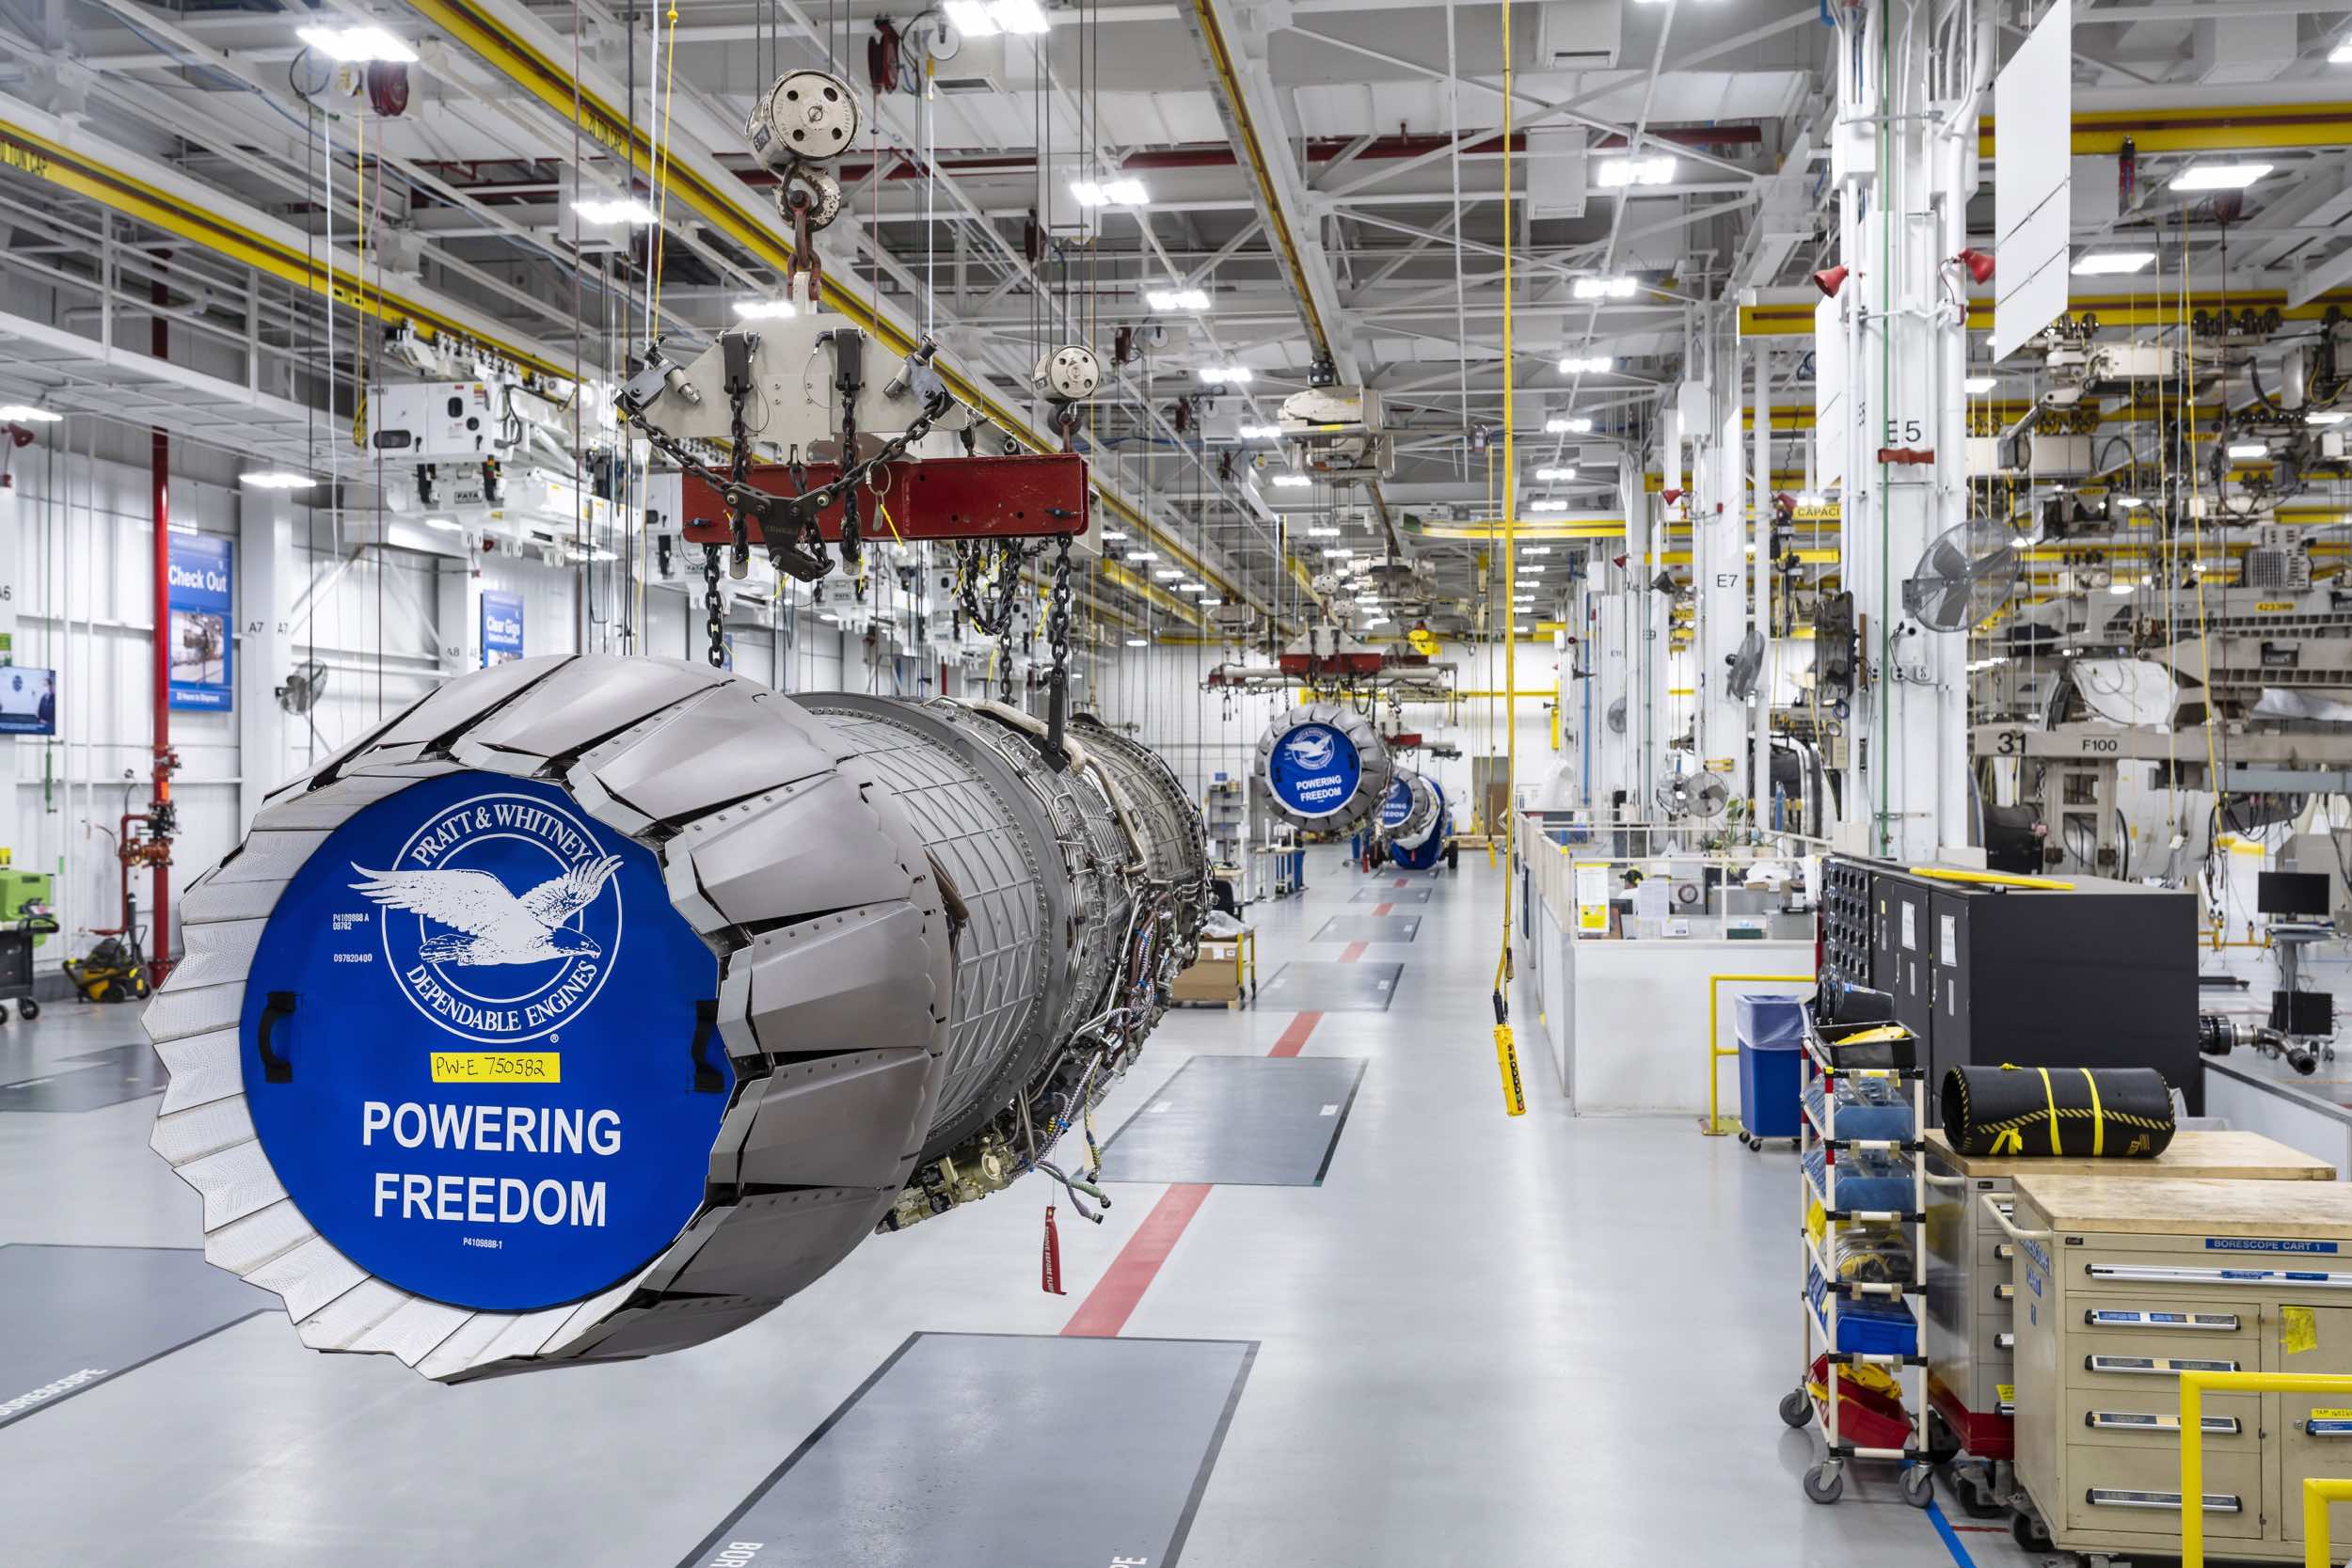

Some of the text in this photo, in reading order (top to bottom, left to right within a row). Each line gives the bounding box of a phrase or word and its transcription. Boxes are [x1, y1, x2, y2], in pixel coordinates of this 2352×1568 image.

[456, 491, 479, 500] FATA
[168, 564, 204, 590] Check
[206, 571, 228, 593] Out
[1717, 574, 1739, 588] E7
[248, 622, 263, 633] A7
[1997, 733, 2026, 754] 31
[2082, 739, 2118, 752] F100
[1295, 775, 1343, 791] POWERING
[1300, 787, 1342, 802] FREEDOM
[411, 804, 594, 867] PRATT & WHITNEY
[364, 913, 370, 922] A
[406, 960, 597, 1032] DEPENDABLE ENGINES
[436, 1056, 546, 1077] PW-E 750582
[362, 1101, 622, 1156] POWERING
[374, 1172, 606, 1227] FREEDOM
[2214, 1240, 2278, 1250] BORESCOPE
[2282, 1243, 2312, 1251] CART
